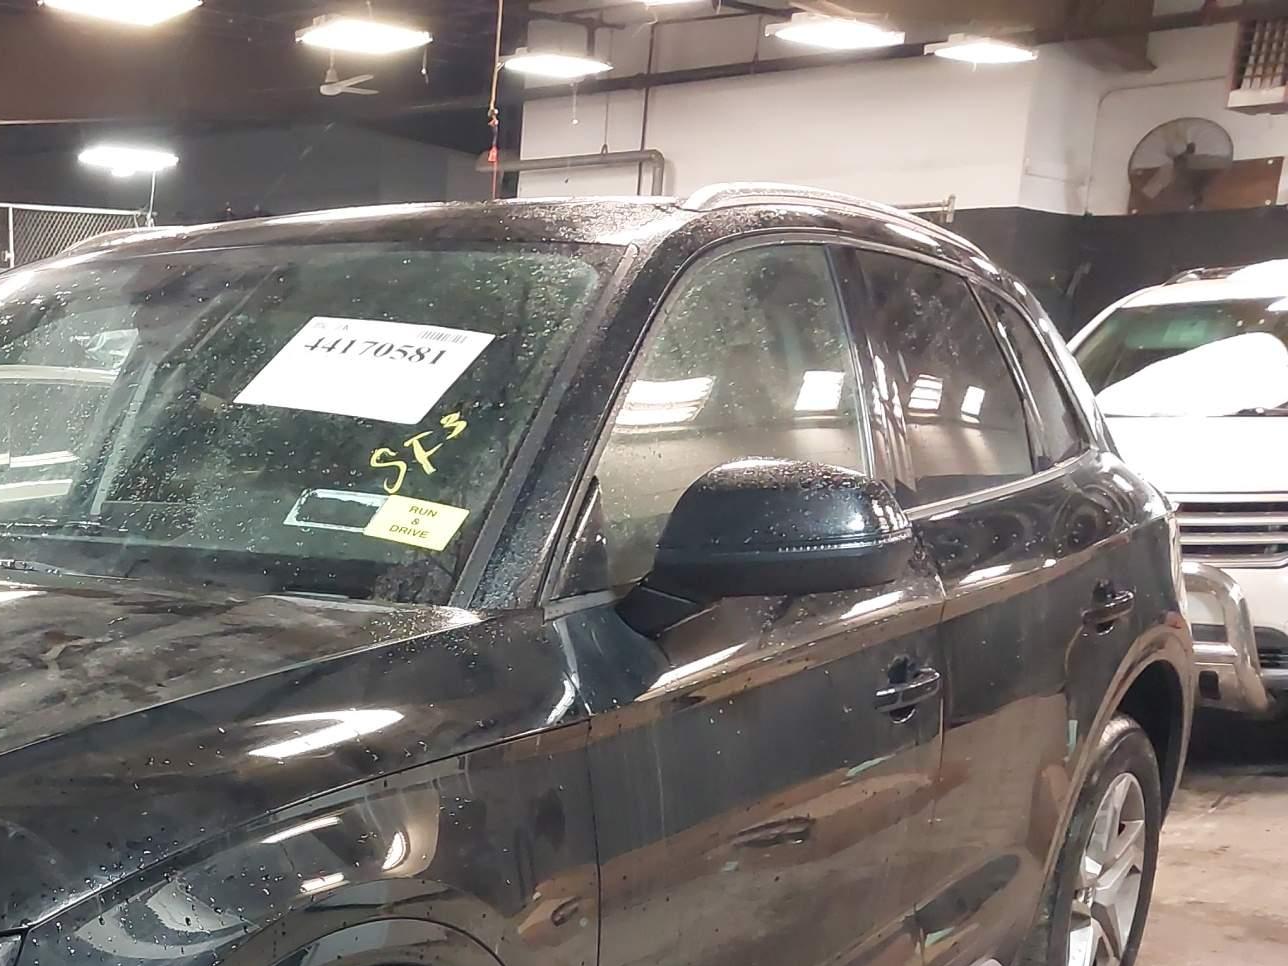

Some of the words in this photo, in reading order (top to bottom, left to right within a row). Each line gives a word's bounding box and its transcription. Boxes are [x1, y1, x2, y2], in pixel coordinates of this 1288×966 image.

[304, 336, 448, 365] 44170581
[408, 504, 439, 518] RUN
[410, 518, 419, 526] &
[388, 524, 430, 539] DRIVE
